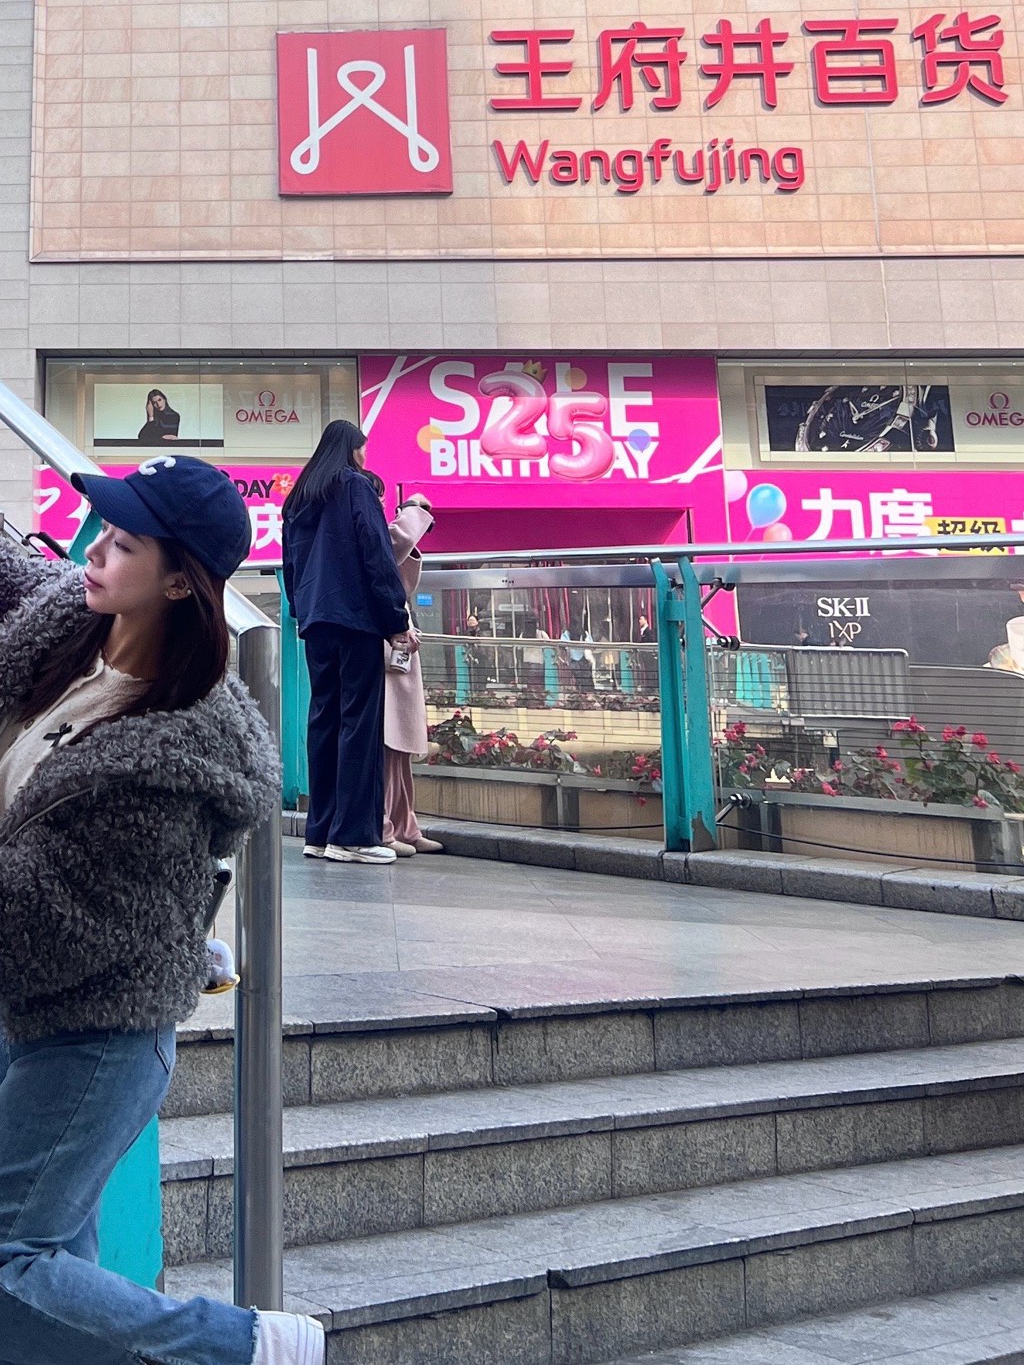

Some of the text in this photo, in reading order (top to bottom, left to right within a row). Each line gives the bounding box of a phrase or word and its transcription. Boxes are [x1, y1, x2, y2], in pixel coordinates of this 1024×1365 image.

[488, 11, 1010, 110] 王府井百货
[492, 137, 806, 194] Wangfujing
[235, 408, 300, 424] OMEGA
[430, 439, 659, 480] BIRHAY
[817, 596, 871, 618] SK-II
